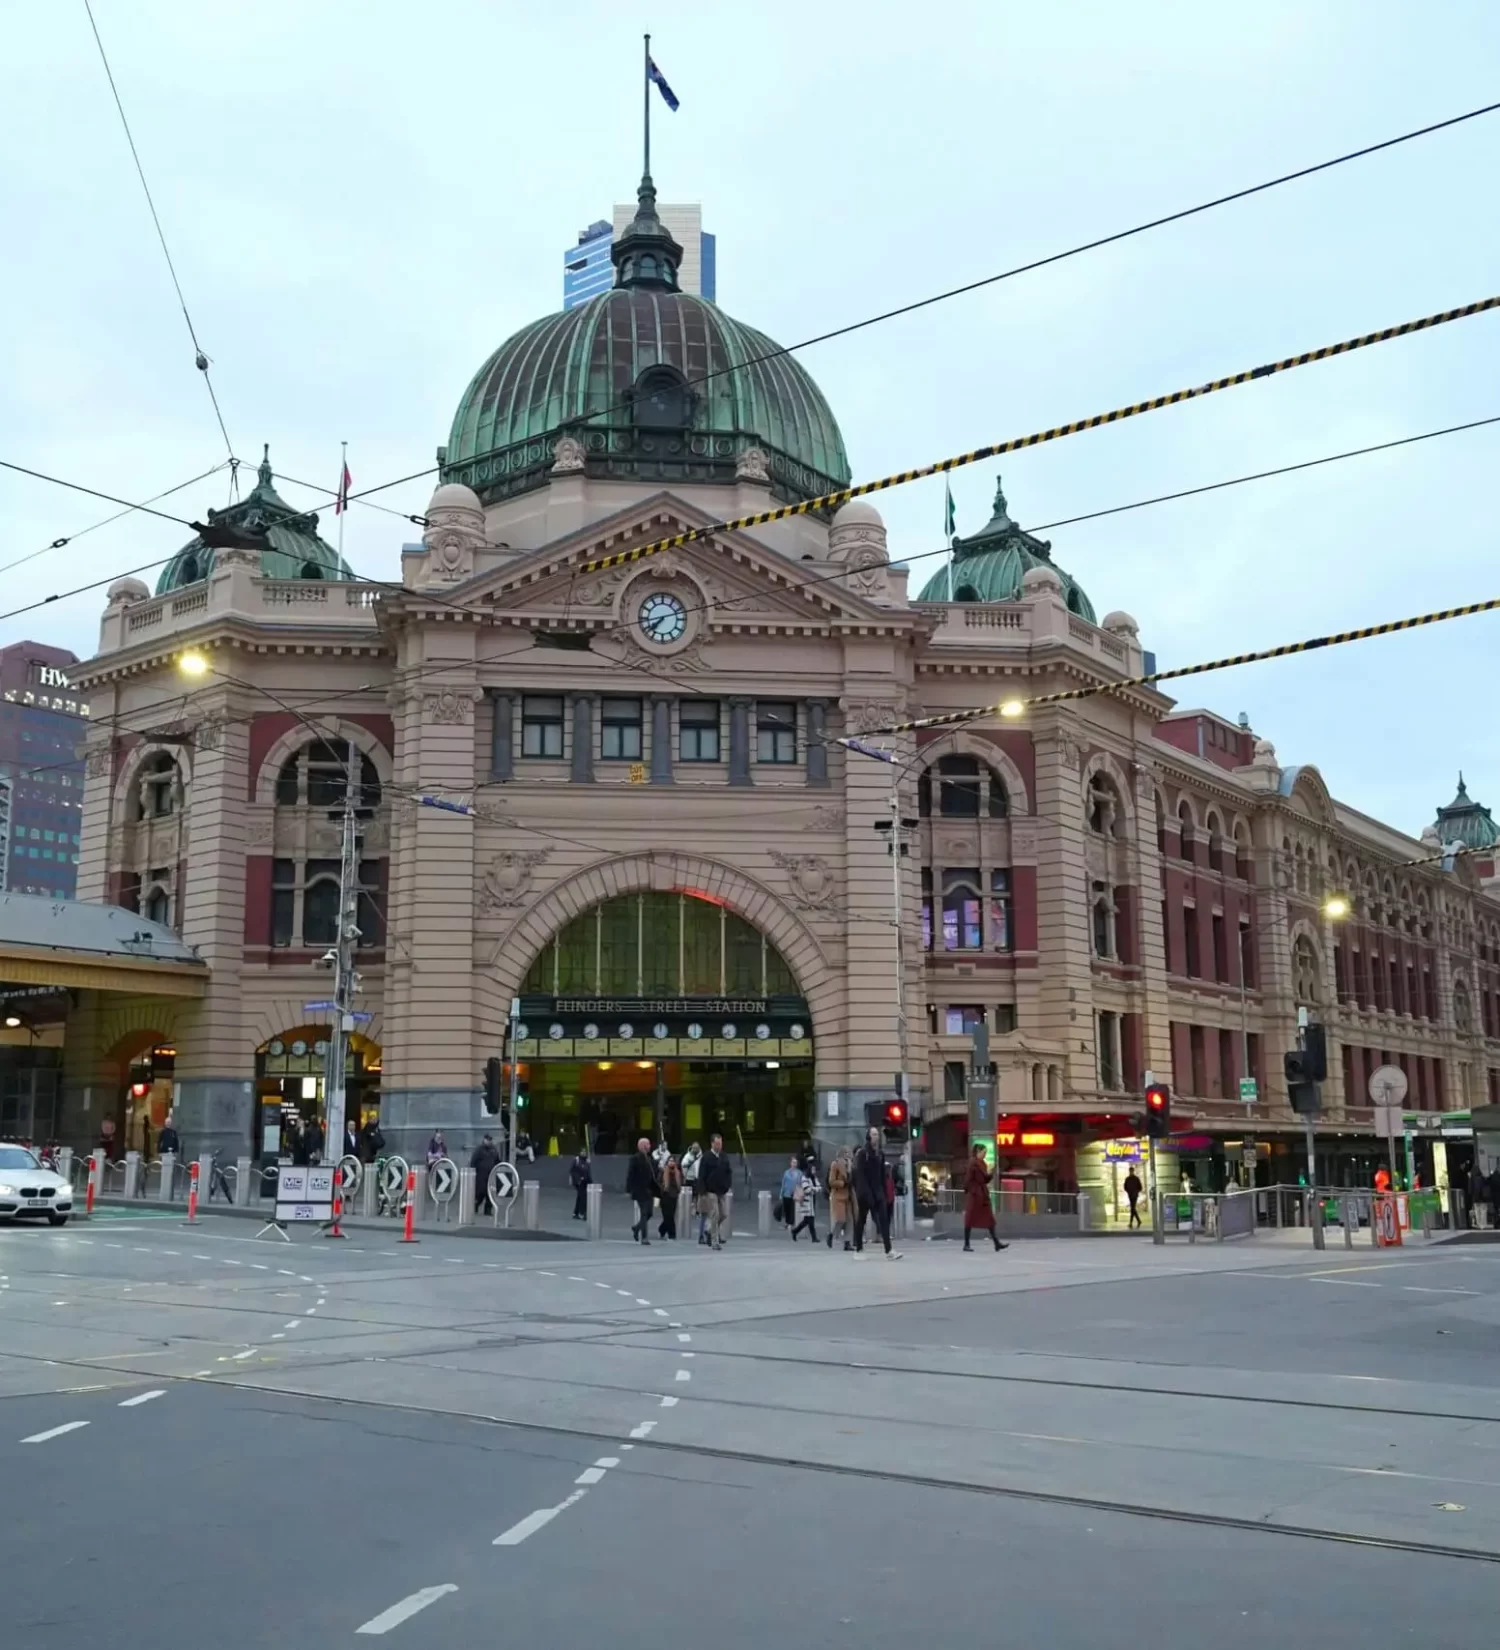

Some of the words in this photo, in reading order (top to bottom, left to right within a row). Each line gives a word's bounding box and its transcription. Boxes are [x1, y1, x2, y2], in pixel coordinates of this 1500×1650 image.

[556, 1000, 622, 1012] FLINDERS
[641, 1001, 688, 1012] STREET
[705, 1001, 766, 1012] STATION
[284, 1177, 303, 1187] MC
[311, 1178, 330, 1188] MC
